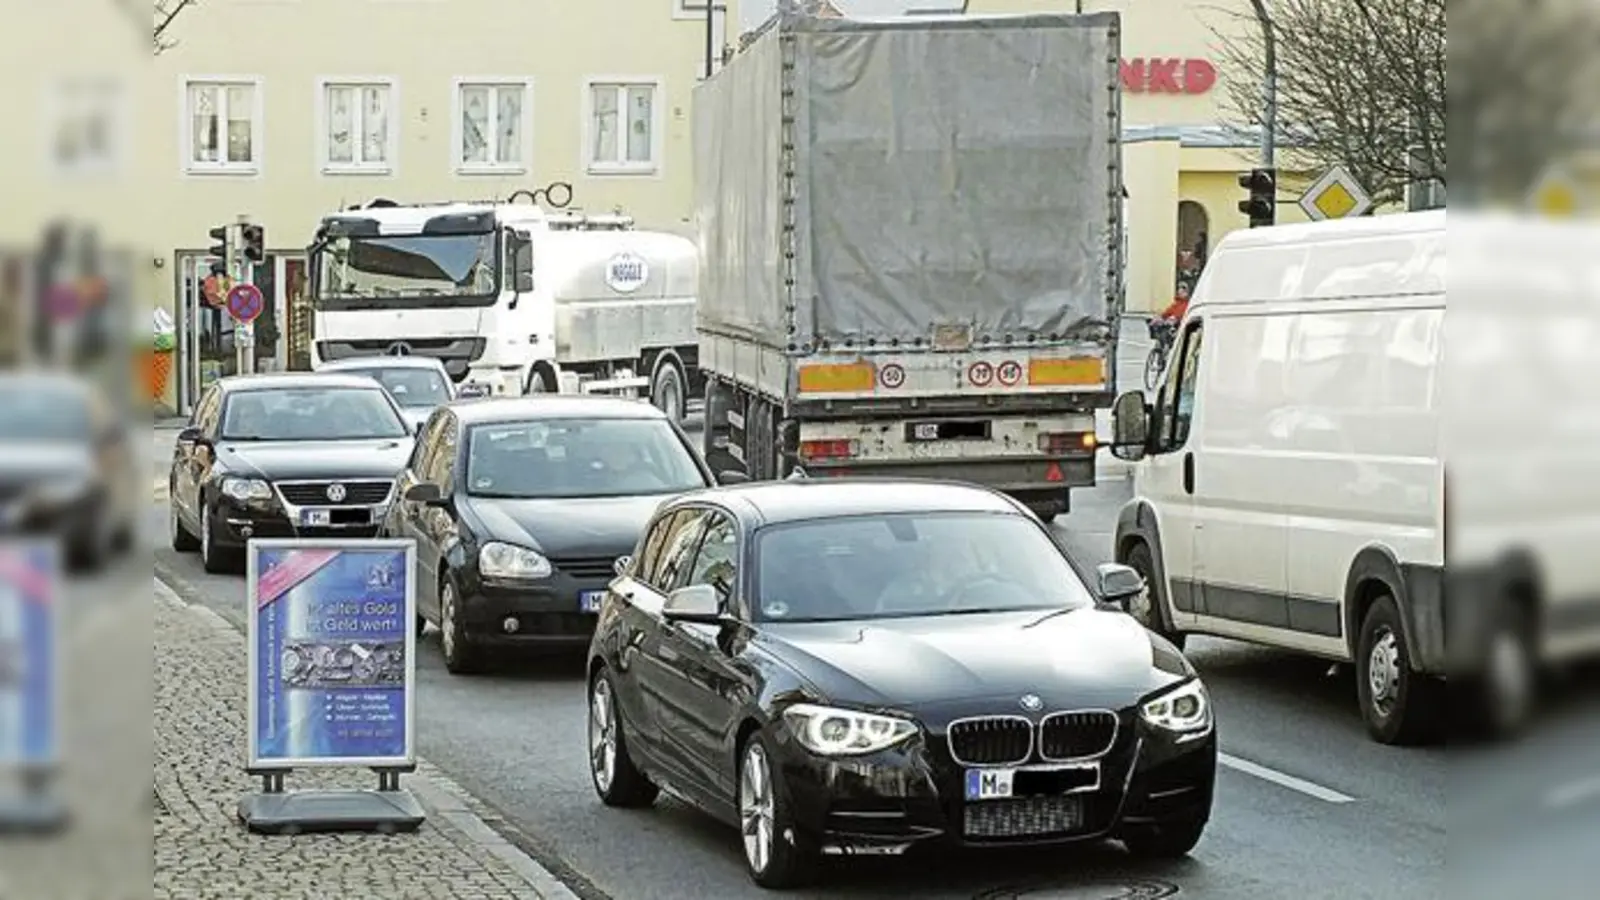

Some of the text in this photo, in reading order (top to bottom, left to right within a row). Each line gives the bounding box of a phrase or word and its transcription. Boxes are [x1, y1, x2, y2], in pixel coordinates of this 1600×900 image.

[1119, 58, 1216, 93] NKD
[364, 601, 397, 615] Gold
[982, 774, 997, 794] M
